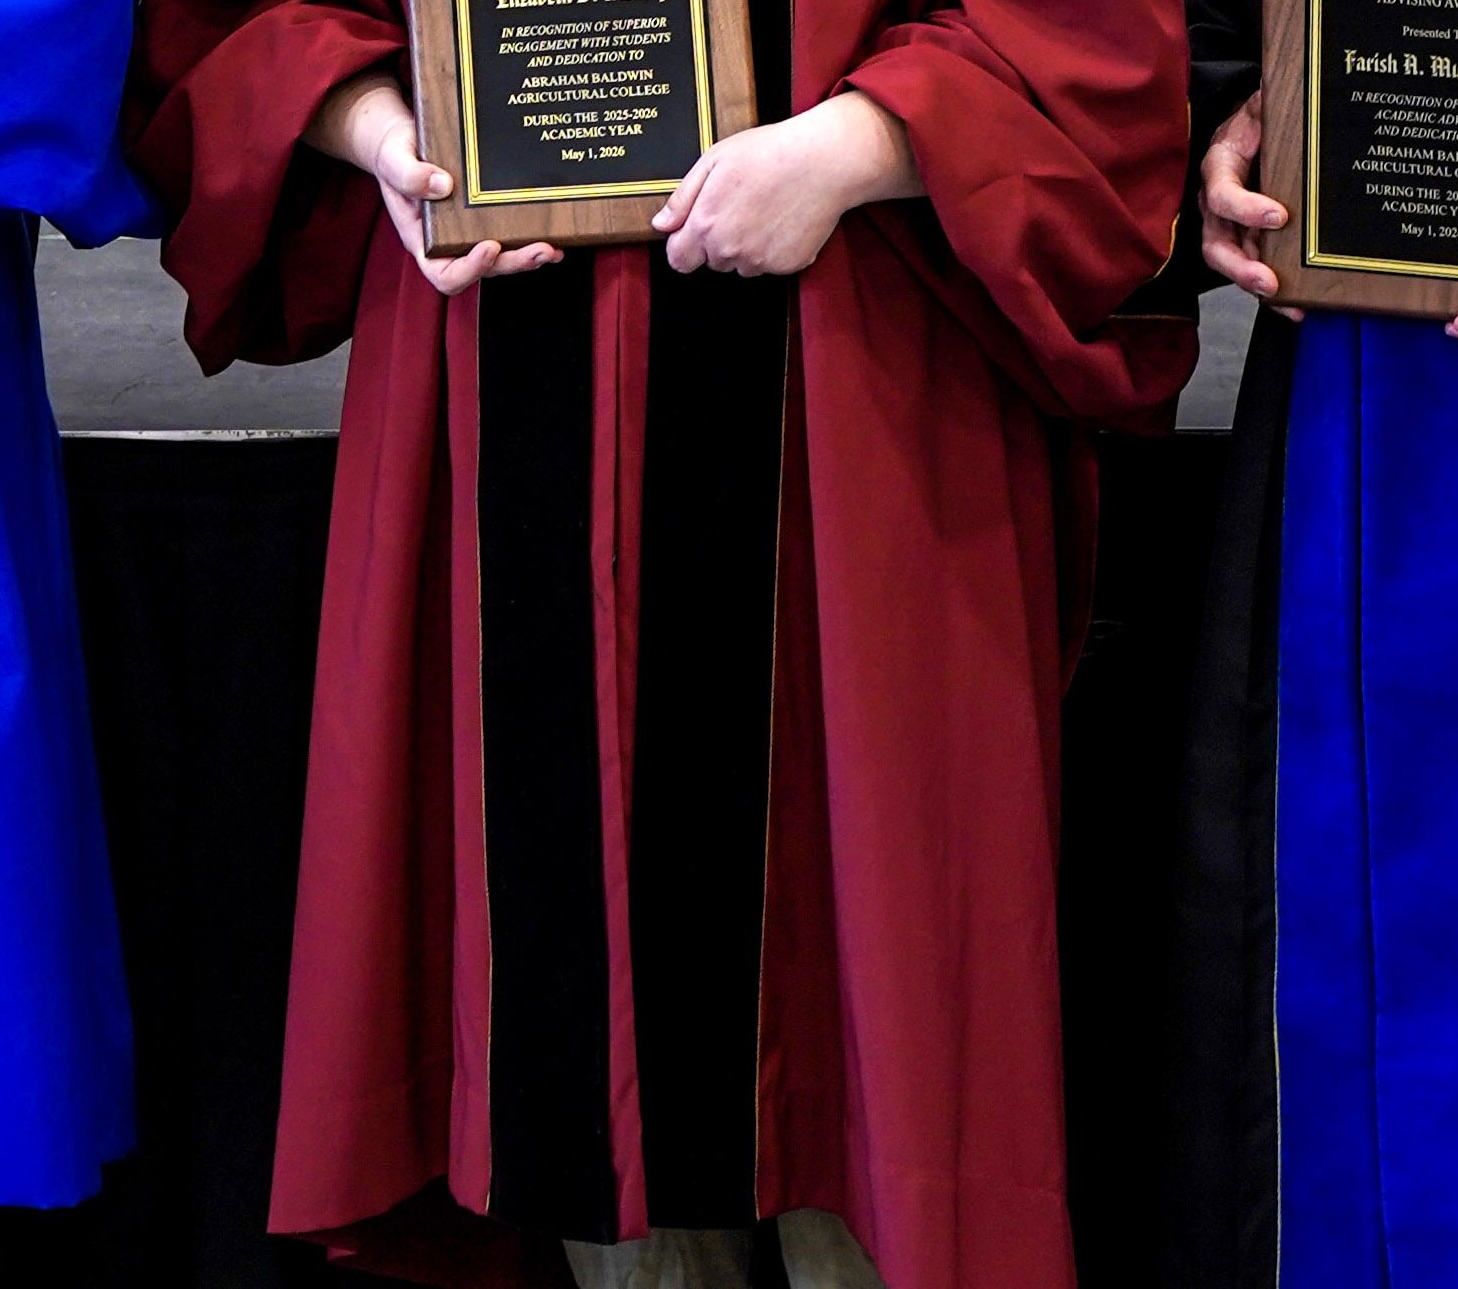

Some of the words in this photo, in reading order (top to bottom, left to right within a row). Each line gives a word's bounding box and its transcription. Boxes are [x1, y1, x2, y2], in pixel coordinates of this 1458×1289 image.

[500, 26, 515, 39] IN
[515, 21, 593, 37] RECOGNITION
[593, 20, 611, 32] OF
[611, 16, 667, 31] SUPERIOR
[1402, 24, 1451, 39] Presented
[498, 37, 579, 54] ENGAGEMENT
[580, 35, 611, 48] WITH
[611, 31, 671, 46] STUDENTS
[526, 55, 553, 68] AND
[553, 49, 626, 66] DEDICATION
[627, 48, 645, 61] TO
[1343, 48, 1398, 74] Farish
[1402, 52, 1424, 76] A.
[521, 72, 589, 89] ABRAHAM
[590, 68, 653, 84] BALDWIN
[507, 87, 608, 105] AGRICULTURAL
[609, 82, 670, 98] COLLEGE
[1350, 90, 1364, 101] IN
[1364, 91, 1443, 107] RECOGNITION
[522, 112, 572, 127] DURING
[572, 110, 599, 123] THE
[602, 106, 658, 122] 2025-2026
[1373, 108, 1437, 124] ACADEMIC
[539, 125, 606, 141] ACADEMIC
[607, 123, 643, 136] YEAR
[560, 148, 585, 162] May
[598, 145, 626, 158] 2026
[1366, 144, 1434, 160] ABRAHAM
[1351, 159, 1452, 177] AGRICULTURAL
[1365, 182, 1414, 198] DURING
[1415, 186, 1440, 200] THE
[1381, 200, 1448, 216] ACADEMIC
[1400, 222, 1424, 237] May
